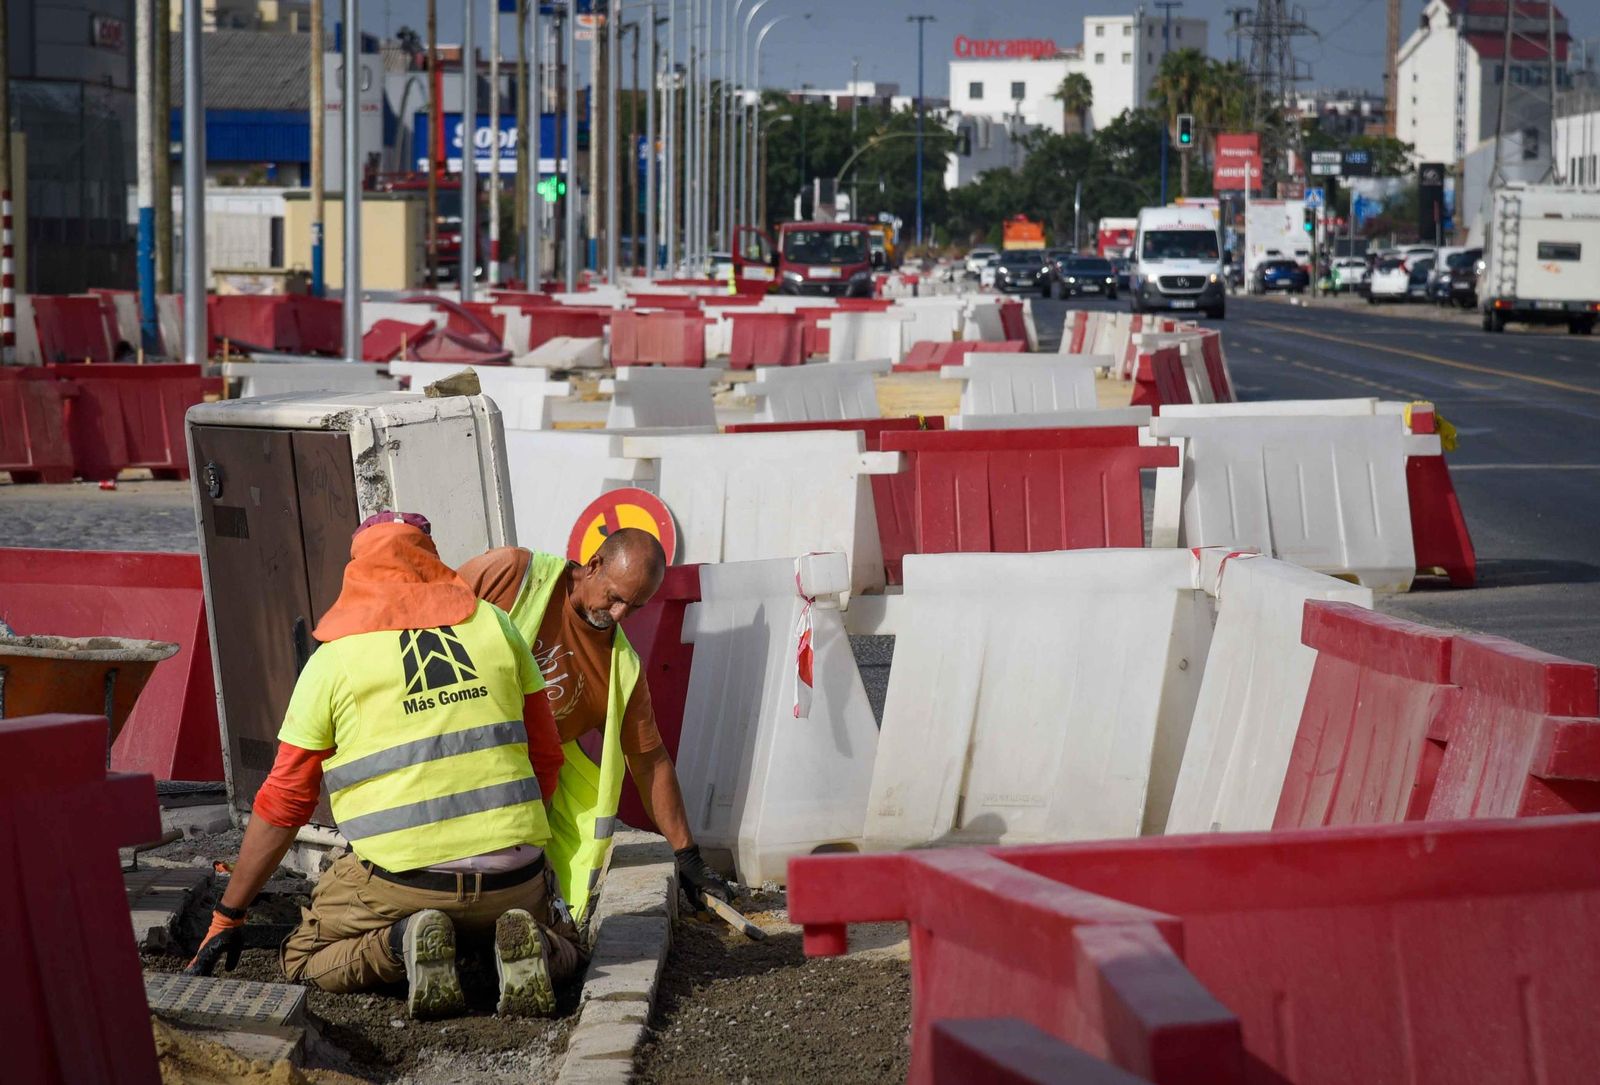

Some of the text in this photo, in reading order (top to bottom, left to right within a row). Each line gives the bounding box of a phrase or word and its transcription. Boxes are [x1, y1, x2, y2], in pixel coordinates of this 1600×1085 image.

[953, 35, 1056, 60] Cruzcampo
[1217, 167, 1261, 178] ABIERO
[403, 685, 488, 715] Más Gomas
